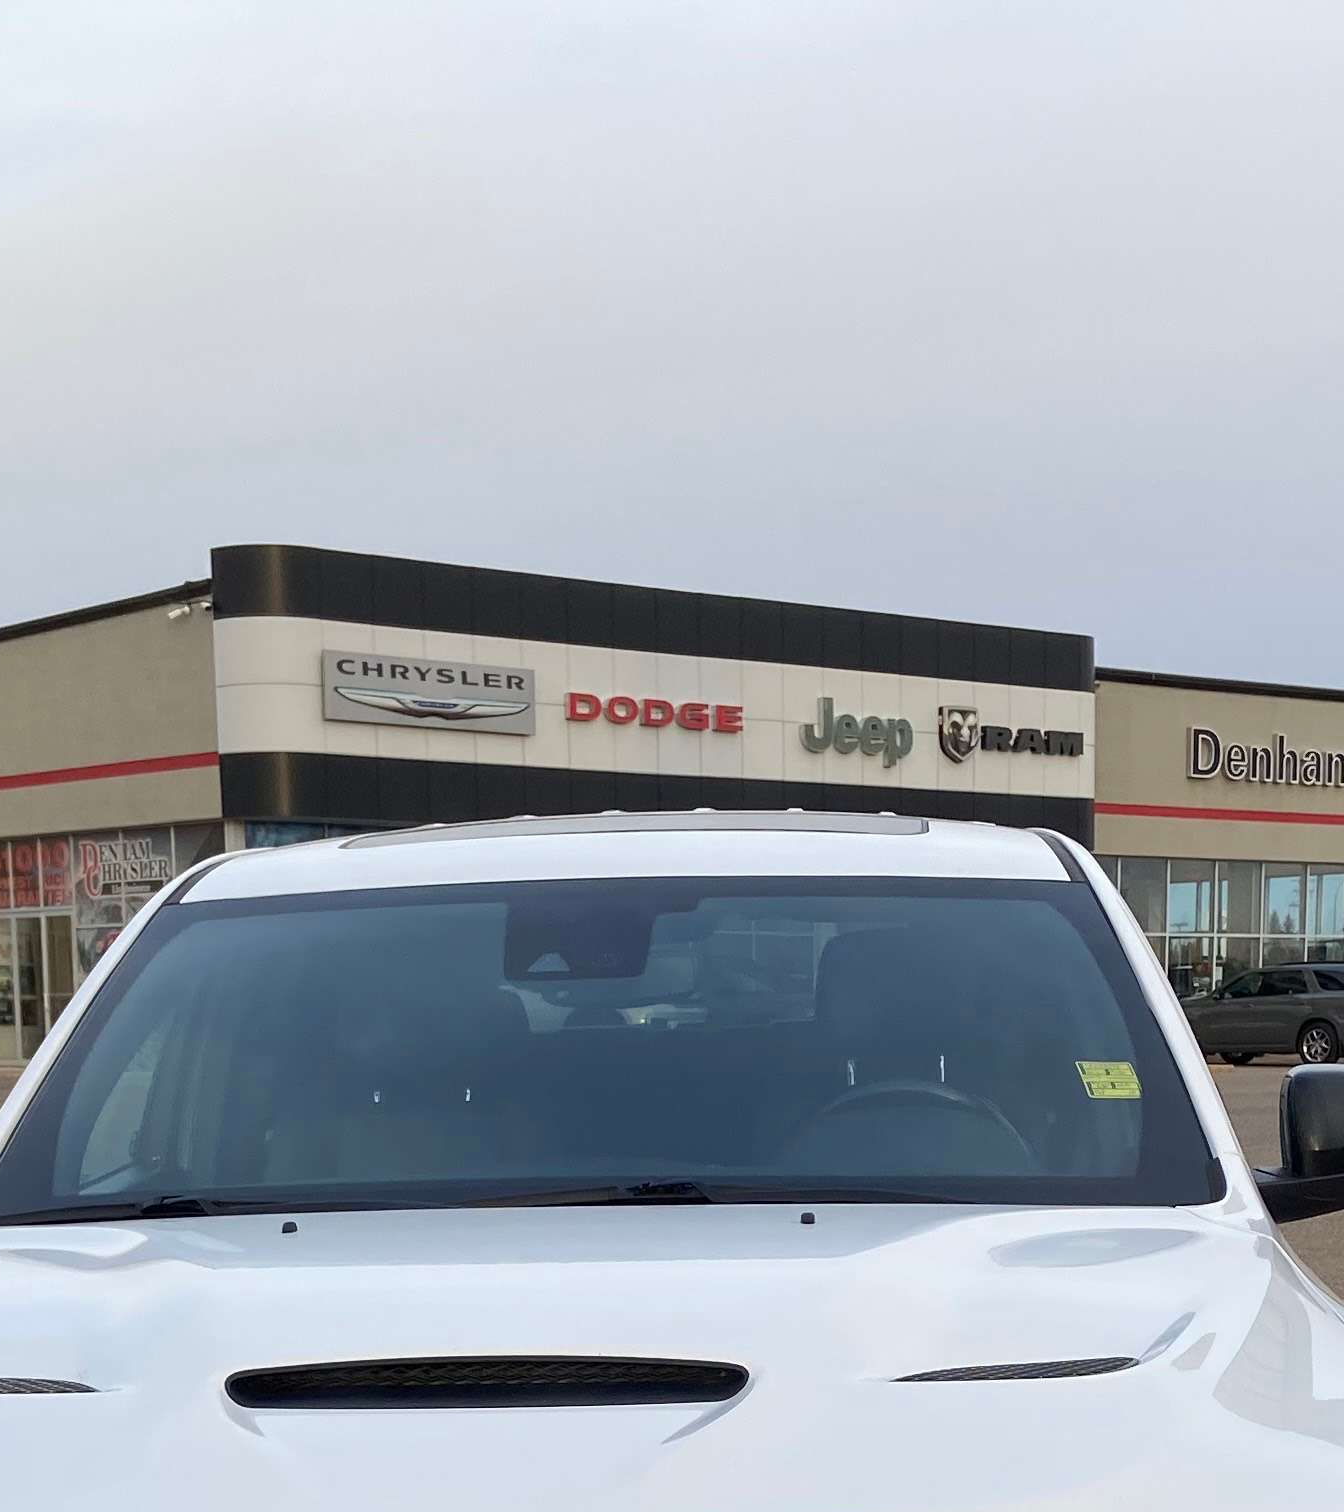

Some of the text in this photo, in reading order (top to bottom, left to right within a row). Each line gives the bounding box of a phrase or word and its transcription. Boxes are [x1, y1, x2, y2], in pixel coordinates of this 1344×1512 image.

[336, 658, 526, 691] CHRYSLER
[565, 691, 744, 733] DODGE
[800, 696, 914, 769] Jeep
[980, 724, 1085, 757] RAM
